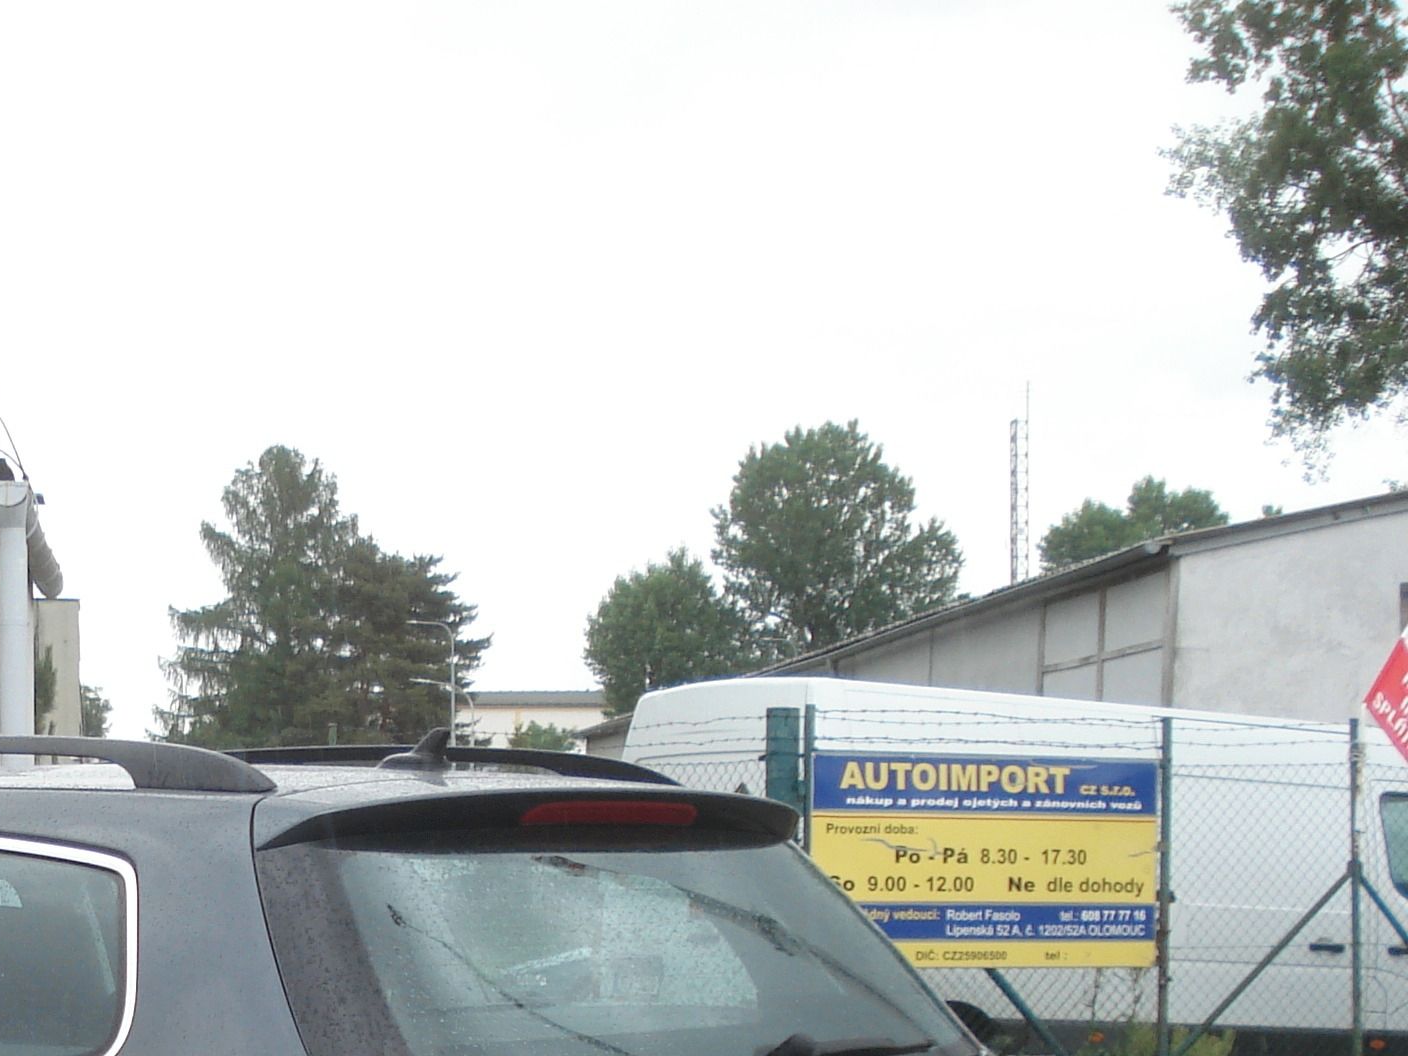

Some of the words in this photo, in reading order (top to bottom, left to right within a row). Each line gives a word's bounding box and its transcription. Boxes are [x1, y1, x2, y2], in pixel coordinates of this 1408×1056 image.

[839, 760, 1072, 794] AUTOIMPORT
[846, 796, 893, 808] nákup
[897, 798, 907, 806] a
[911, 797, 959, 809] prodej
[962, 797, 1018, 810] ojetých
[1021, 800, 1031, 808] a
[884, 824, 919, 835] doba:
[894, 845, 921, 864] Po
[943, 847, 968, 864] Pá
[979, 848, 1018, 865] 8.30
[1041, 848, 1087, 865] 17.30
[867, 876, 906, 892] 9.00
[926, 876, 974, 892] 12.00
[1007, 876, 1035, 893] Ne
[1047, 876, 1073, 893] dle
[1079, 877, 1145, 897] dohody
[946, 908, 983, 921] Robert
[1102, 909, 1117, 922] 77
[1118, 909, 1132, 922] 77
[1087, 924, 1146, 937] OLOMOUC
[915, 949, 939, 961] DIČ:
